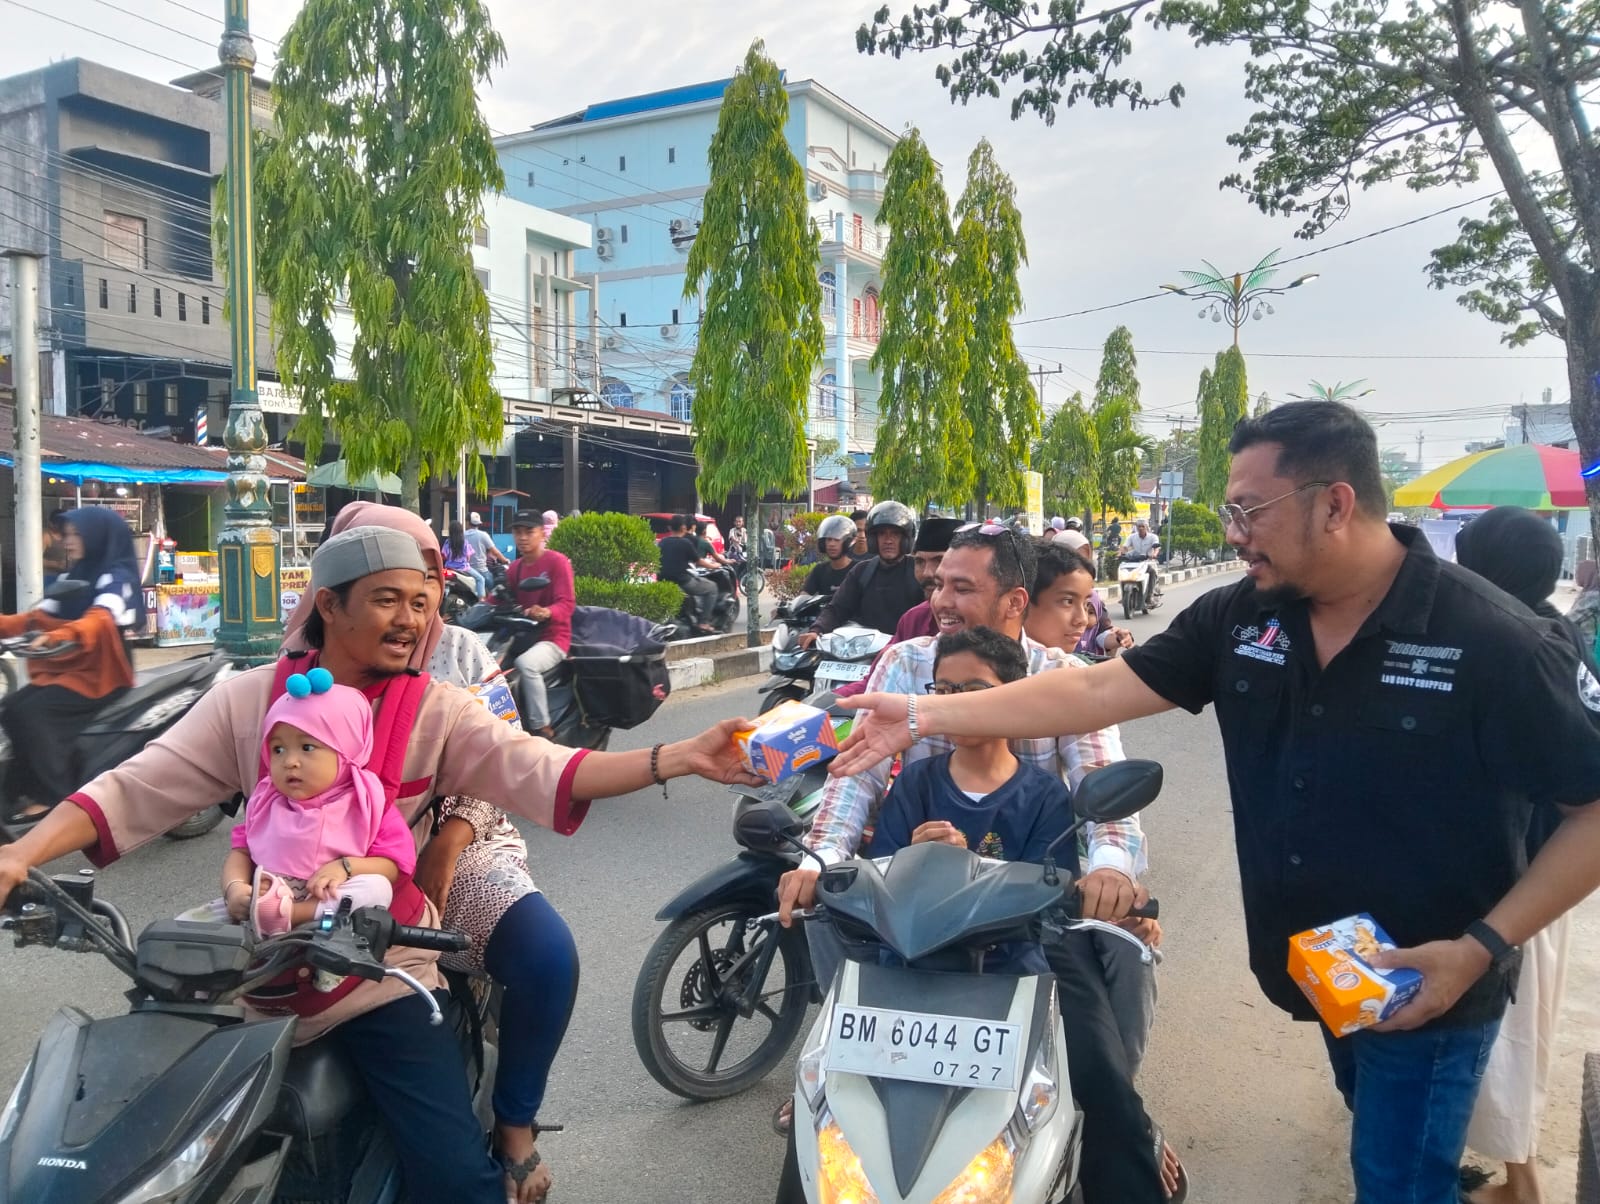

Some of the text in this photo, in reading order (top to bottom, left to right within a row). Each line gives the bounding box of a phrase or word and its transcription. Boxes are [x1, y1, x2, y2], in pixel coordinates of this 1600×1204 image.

[280, 571, 305, 581] YAM
[280, 581, 308, 590] PREK
[839, 1013, 1010, 1056] BM 6044 GT
[37, 1156, 87, 1170] HONDA
